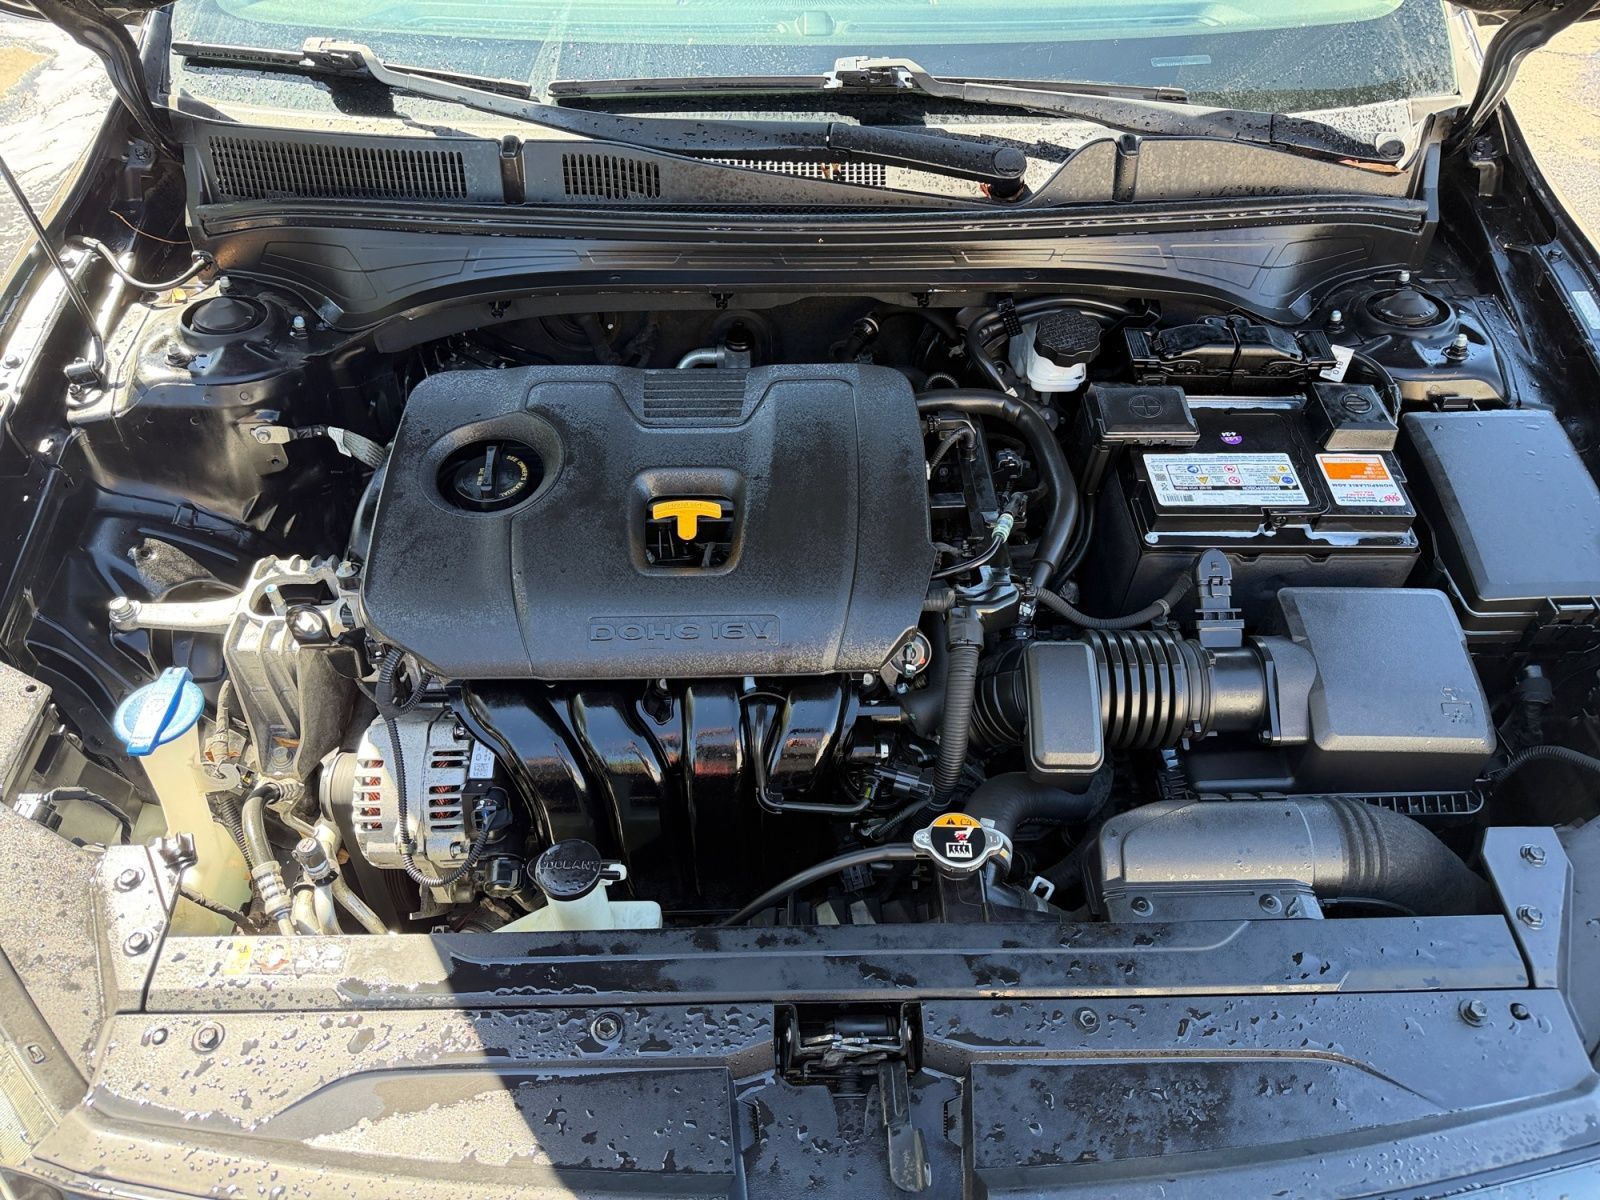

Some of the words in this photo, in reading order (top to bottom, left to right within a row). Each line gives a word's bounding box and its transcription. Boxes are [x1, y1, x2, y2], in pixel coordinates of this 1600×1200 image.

[500, 481, 524, 497] MANUAL
[589, 622, 701, 642] DOHC
[710, 621, 776, 641] 16V
